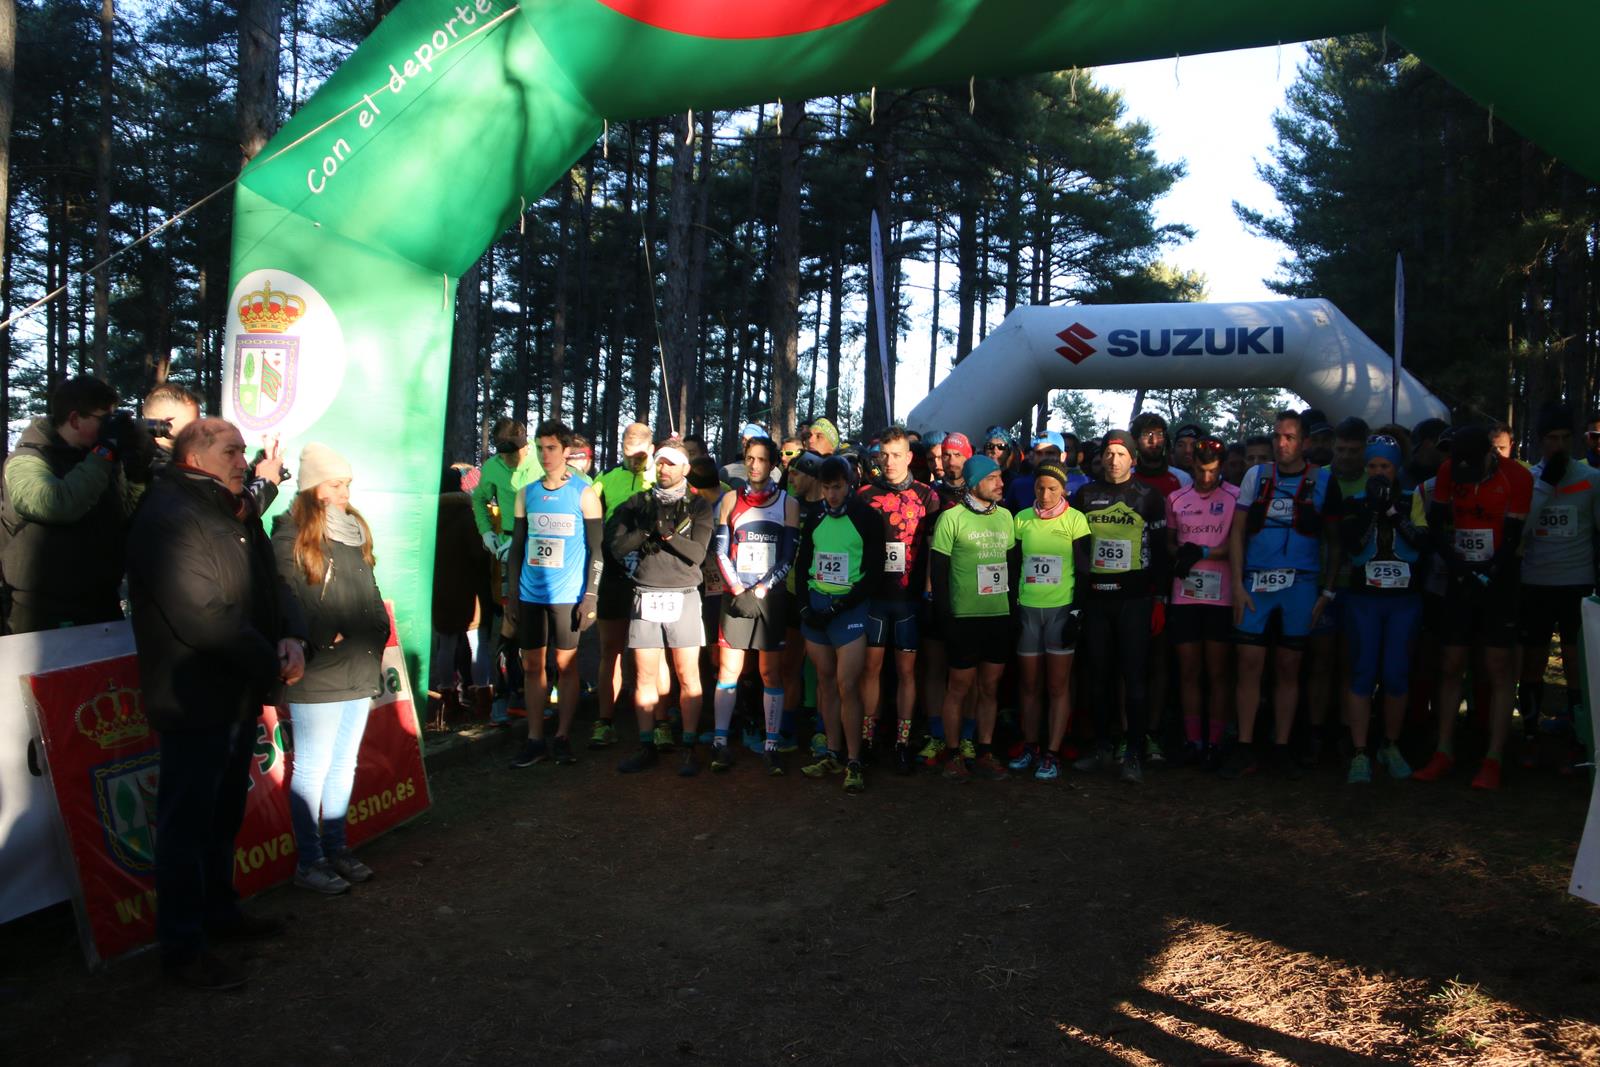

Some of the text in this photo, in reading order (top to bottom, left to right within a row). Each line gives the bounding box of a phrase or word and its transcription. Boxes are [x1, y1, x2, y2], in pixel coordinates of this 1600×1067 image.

[358, 94, 380, 128] el
[1107, 326, 1284, 357] SUZUKI
[1539, 516, 1569, 526] 308
[537, 546, 553, 558] 20
[1098, 547, 1123, 559] 363
[818, 561, 841, 572] 142
[1033, 563, 1050, 574] 10
[993, 572, 1000, 583] 9
[1373, 567, 1402, 578] 259
[1195, 579, 1204, 590] 3
[1260, 574, 1287, 585] 463
